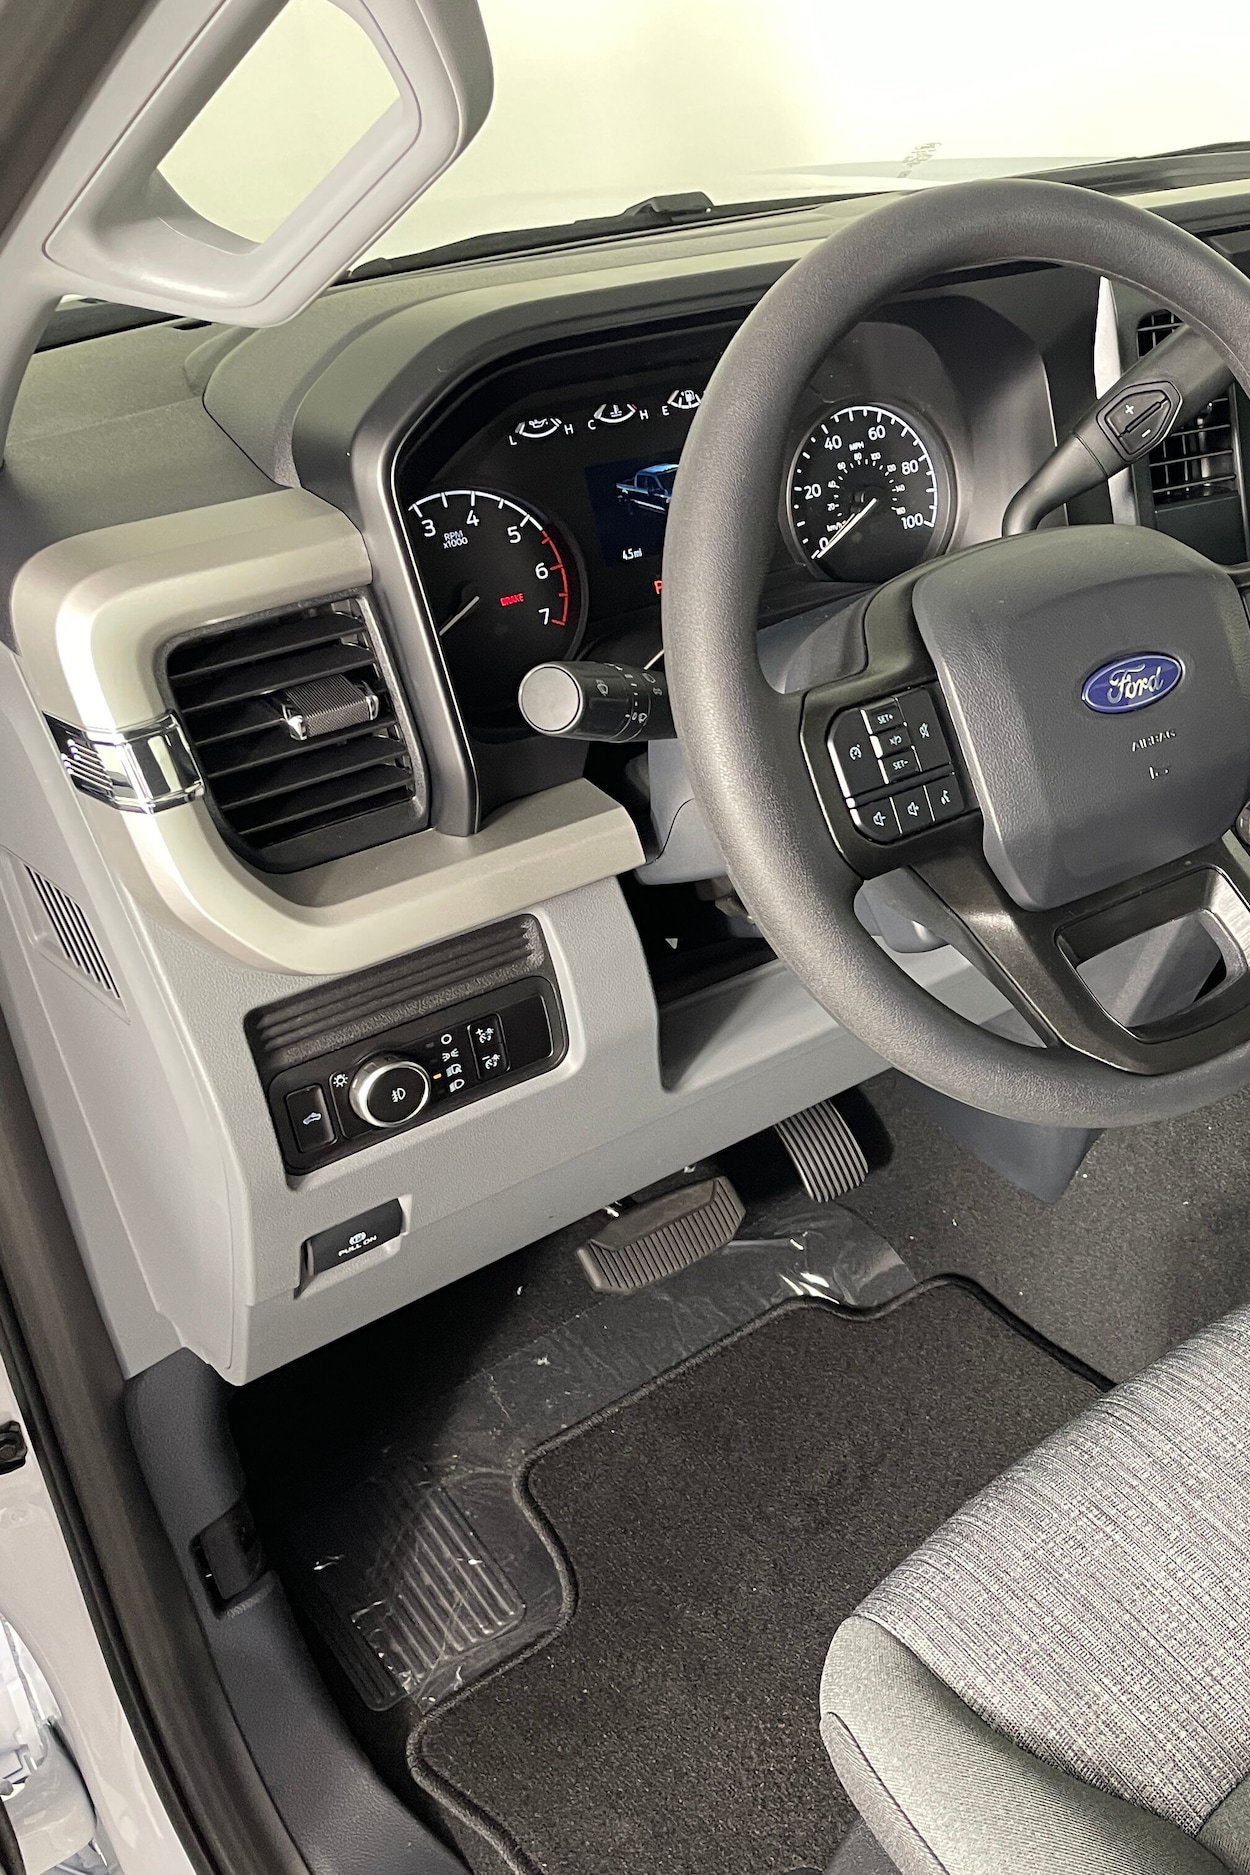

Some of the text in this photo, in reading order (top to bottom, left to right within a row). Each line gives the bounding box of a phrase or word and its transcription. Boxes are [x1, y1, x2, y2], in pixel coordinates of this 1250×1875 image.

[640, 410, 649, 420] H
[564, 424, 574, 435] H
[588, 420, 596, 430] C
[868, 425, 886, 440] 60
[509, 435, 517, 445] L
[824, 435, 842, 450] 40
[849, 441, 865, 451] MPH
[901, 460, 918, 475] 80
[804, 484, 821, 500] 20
[466, 510, 479, 526] 4
[901, 513, 923, 529] 100
[422, 519, 436, 537] 3
[444, 530, 464, 541] RPM
[508, 526, 521, 544] 5
[443, 536, 468, 549] x1000
[535, 562, 549, 580] 6
[500, 592, 524, 607] BRAKE
[538, 608, 550, 625] 7
[1107, 664, 1164, 704] Ford
[338, 1235, 377, 1256] PULL ON
